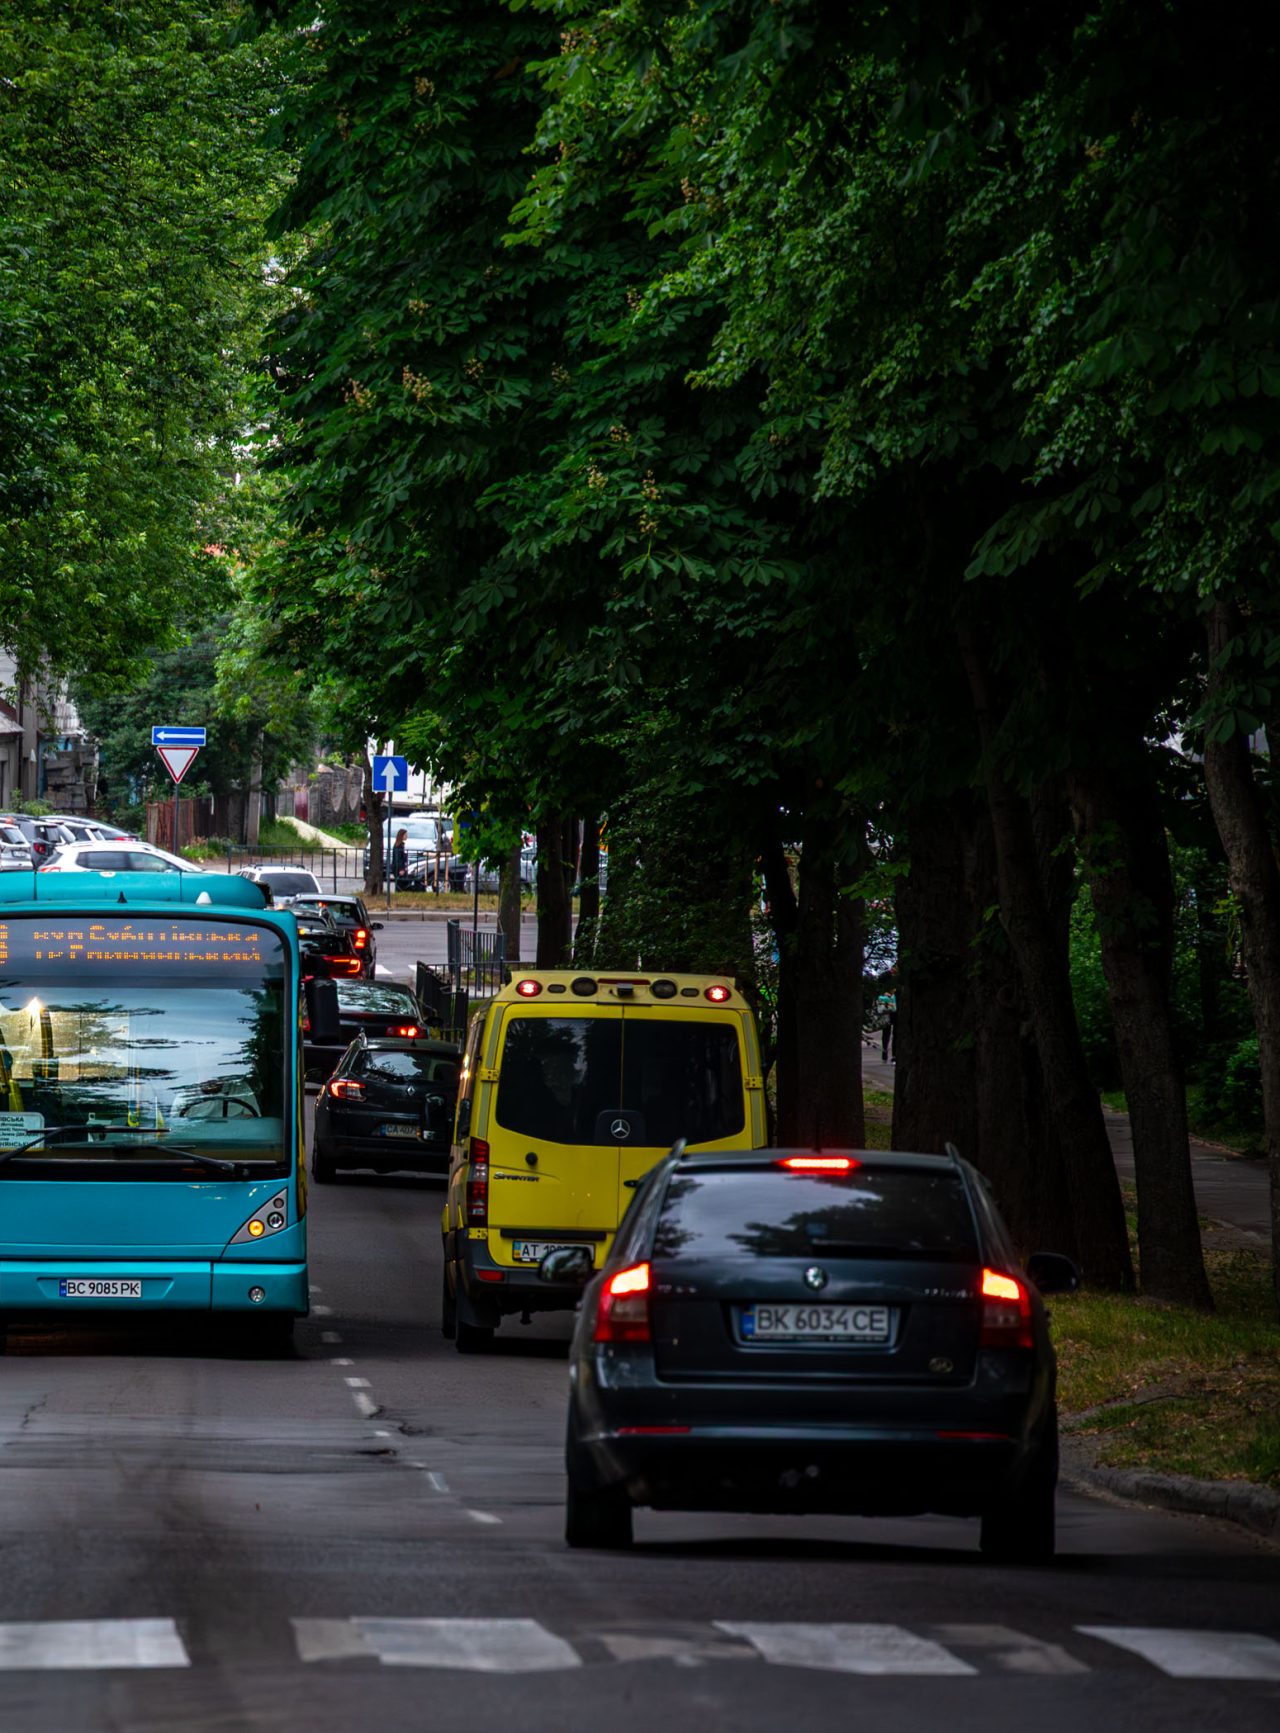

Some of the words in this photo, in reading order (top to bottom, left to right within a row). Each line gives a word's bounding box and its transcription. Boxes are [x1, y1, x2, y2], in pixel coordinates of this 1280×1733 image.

[522, 1244, 539, 1256] AT
[67, 1282, 86, 1294] BC
[88, 1282, 118, 1294] 9085
[120, 1282, 139, 1295] PK
[758, 1309, 790, 1330] BK
[795, 1309, 848, 1331] 6034
[853, 1310, 886, 1331] CE
